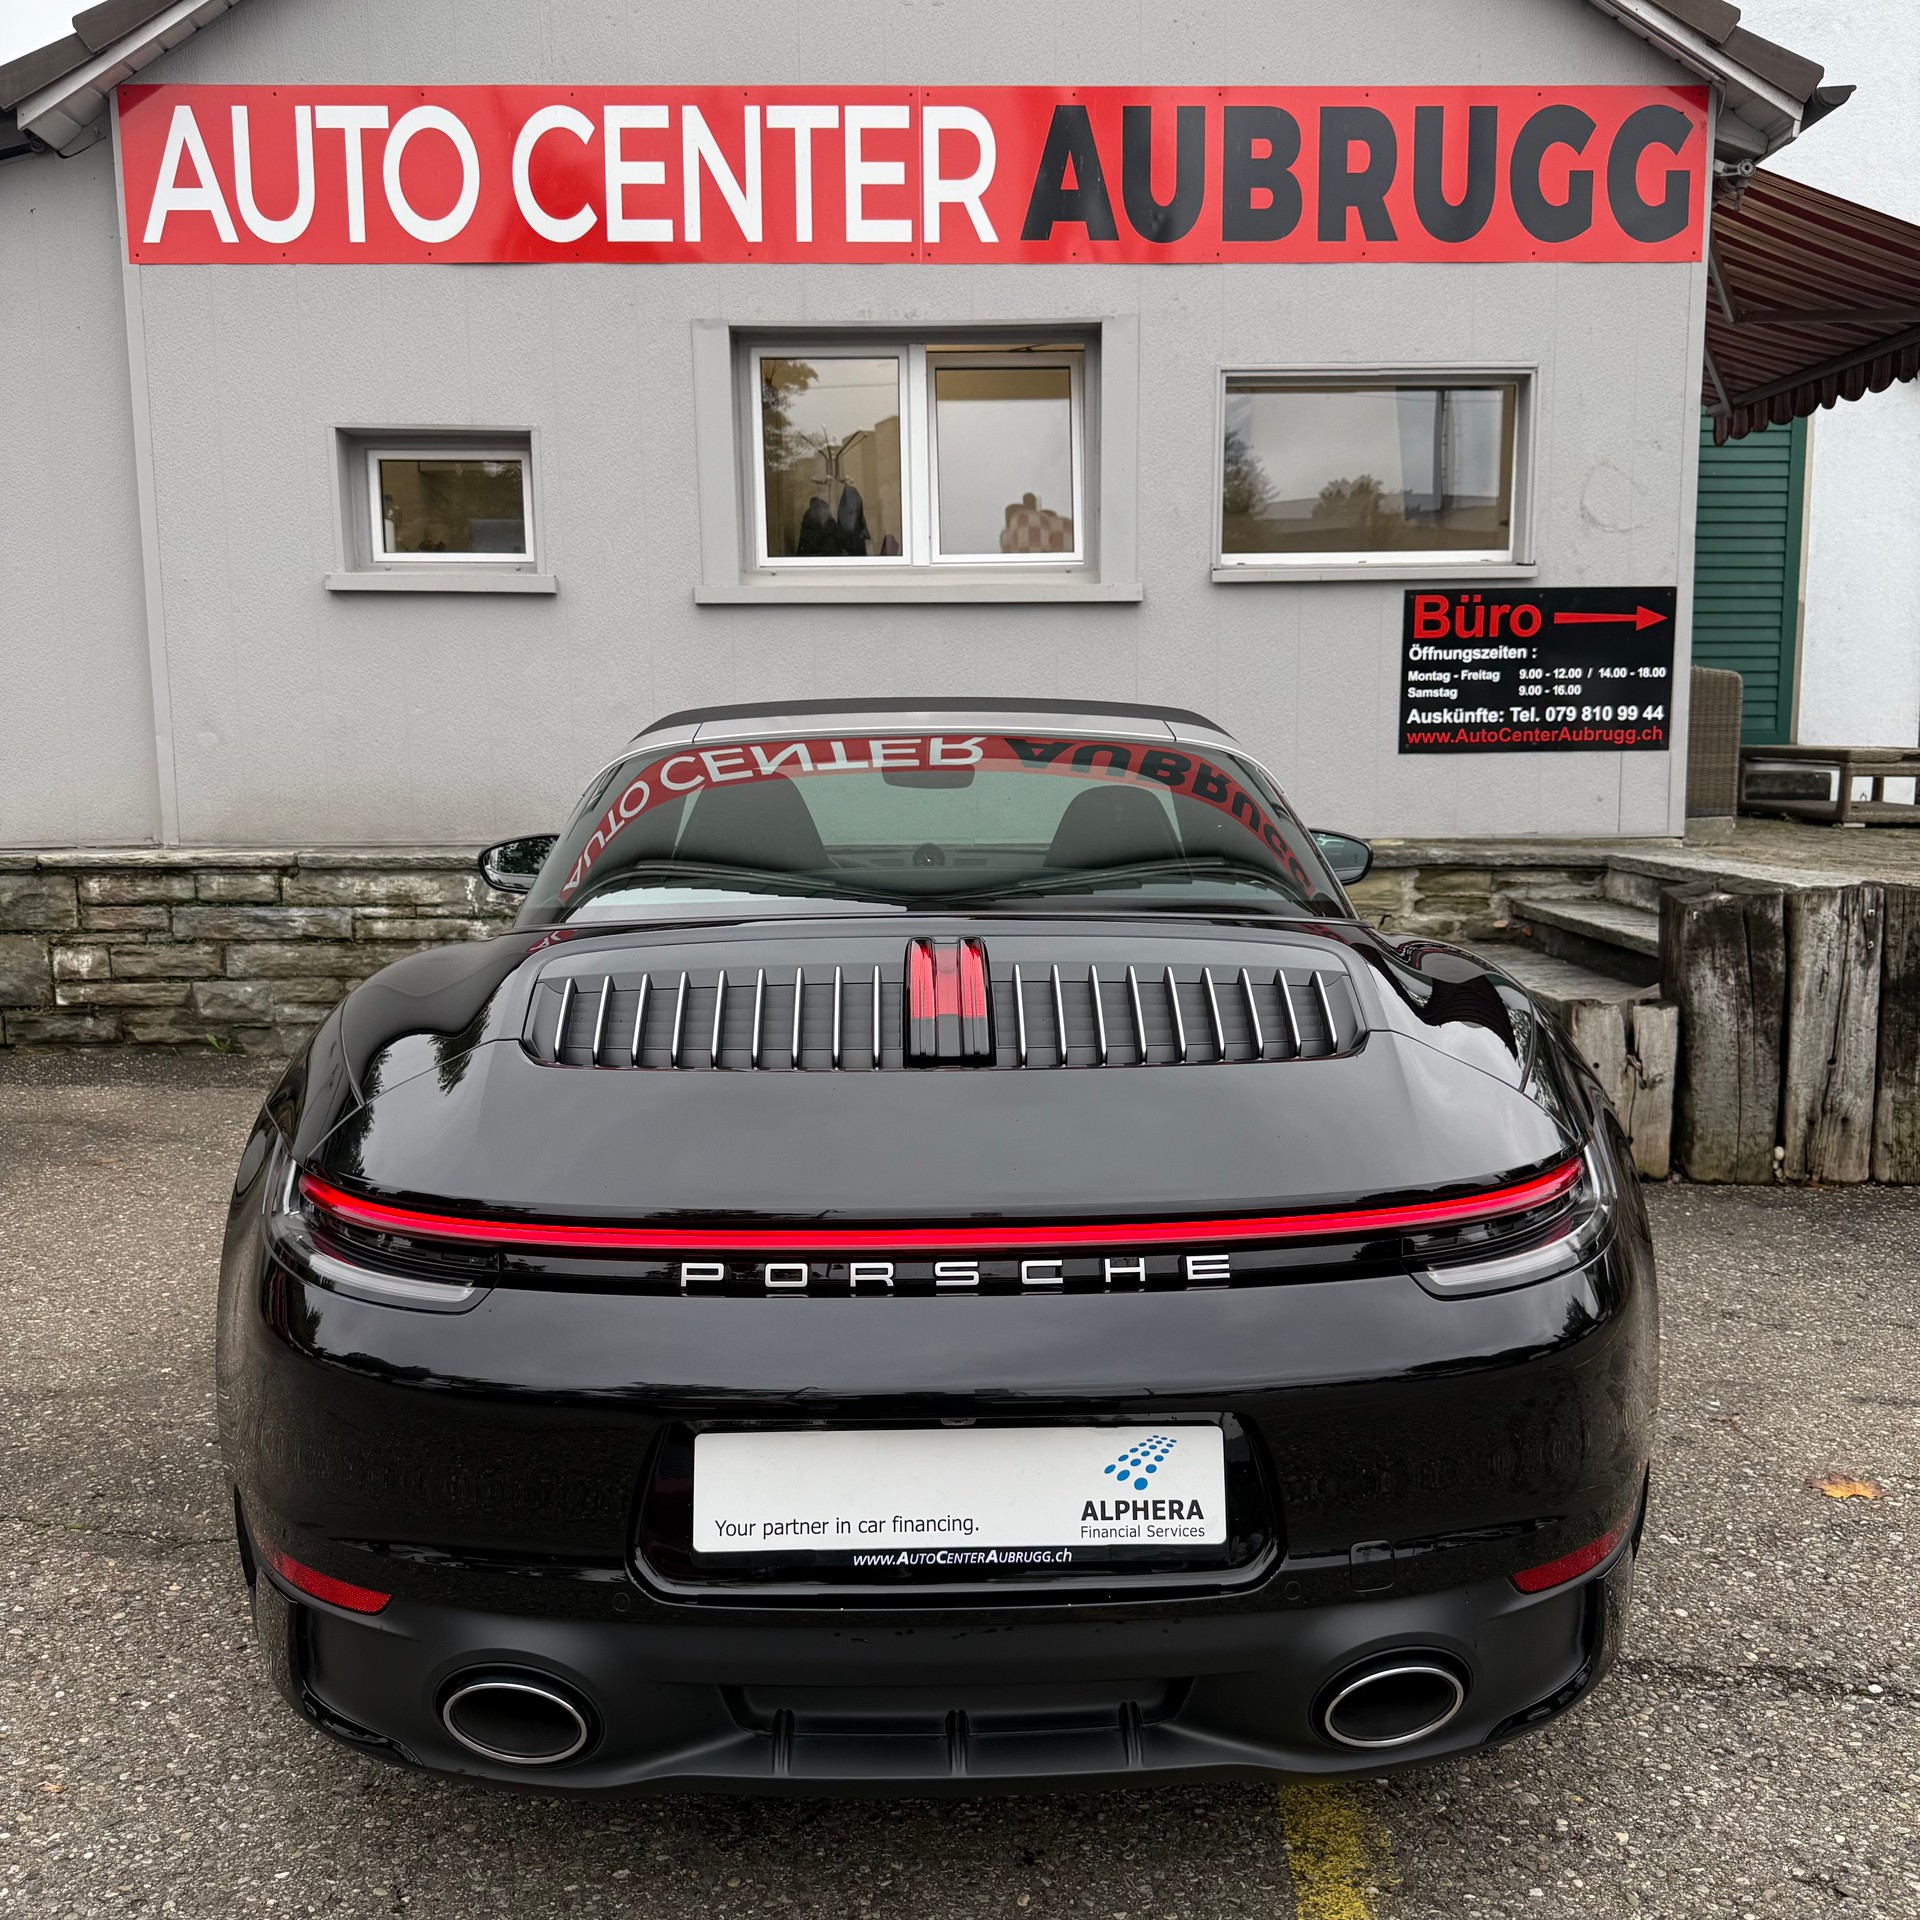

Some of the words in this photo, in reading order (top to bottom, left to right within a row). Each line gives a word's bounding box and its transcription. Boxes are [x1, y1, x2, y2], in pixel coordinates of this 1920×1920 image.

[142, 104, 481, 244] AUTO
[512, 104, 1000, 244] CENTER
[1019, 104, 1695, 244] AUBRUGG
[1413, 594, 1542, 639] Büro
[1409, 643, 1527, 663] Öffnungszeiten
[1407, 670, 1451, 683] Montag
[1460, 669, 1501, 682] Freitag
[1518, 668, 1543, 679] 9.00
[1552, 668, 1582, 679] 12.00
[1598, 667, 1627, 678] 14.00
[1637, 667, 1667, 678] 18.00
[1407, 687, 1458, 700] Samstag
[1518, 685, 1542, 696] 9.00
[1552, 684, 1582, 696] 16.00
[1406, 707, 1505, 724] Auskünfte:
[1509, 706, 1540, 722] Tel.
[1545, 706, 1577, 722] 079
[1581, 705, 1613, 721] 810
[1617, 705, 1638, 721] 99
[1642, 704, 1665, 720] 44
[1406, 726, 1663, 745] www.AutoCenterAubrugg.ch
[680, 1254, 1230, 1288] PORSCHE
[1080, 1499, 1205, 1522] ALPHERA
[715, 1520, 756, 1537] Your
[763, 1518, 829, 1540] partner
[836, 1517, 851, 1534] in
[858, 1518, 886, 1534] car
[892, 1515, 980, 1536] financing.
[1080, 1524, 1141, 1539] Financial
[1146, 1524, 1206, 1538] Services
